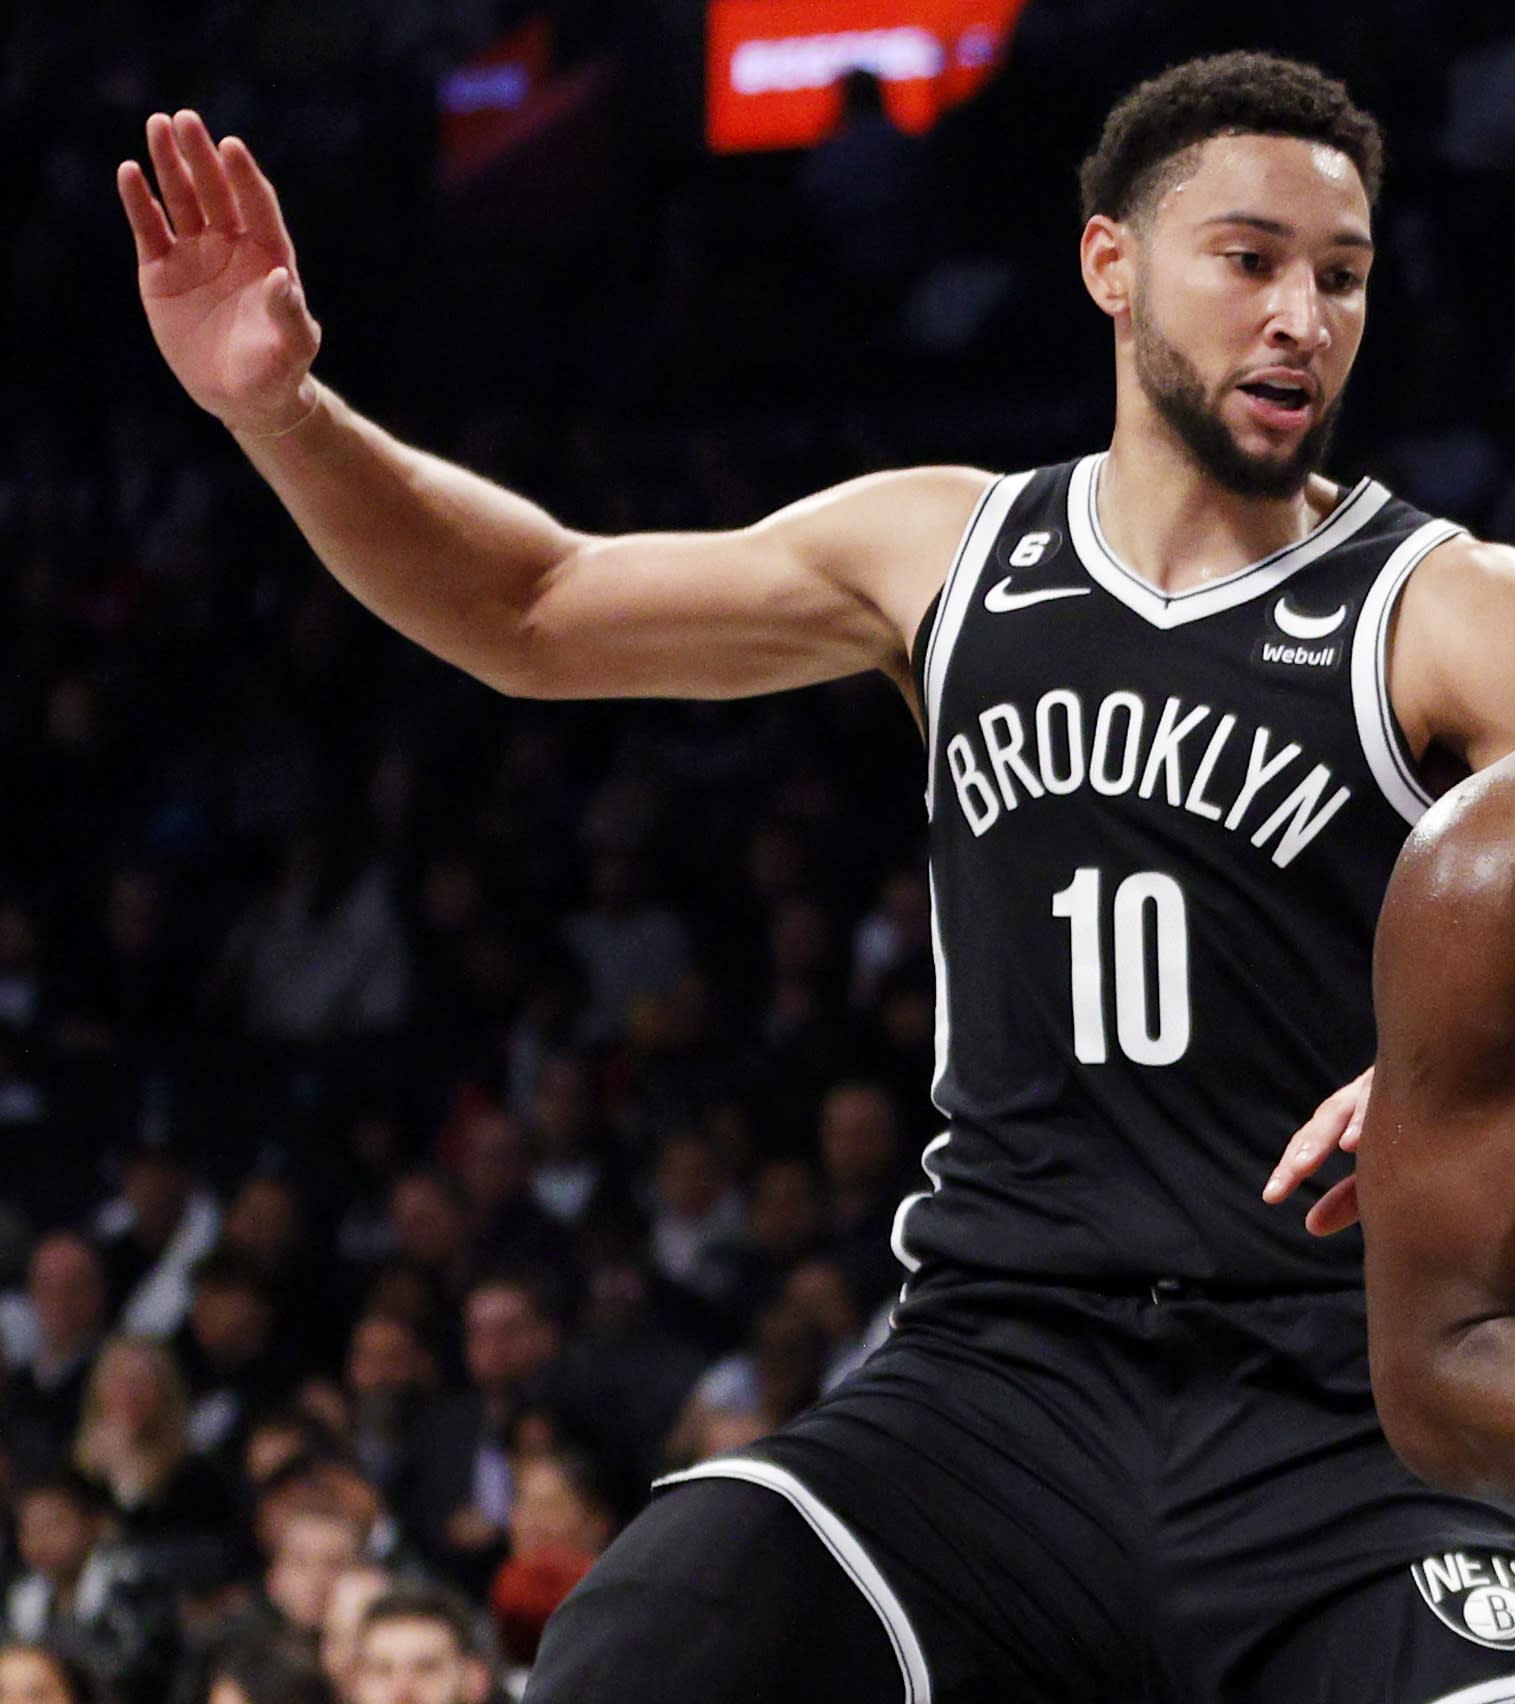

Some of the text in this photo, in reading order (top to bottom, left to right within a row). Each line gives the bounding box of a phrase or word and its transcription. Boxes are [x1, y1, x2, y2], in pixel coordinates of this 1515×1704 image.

[1009, 532, 1050, 567] 6
[1263, 643, 1334, 666] Webull
[946, 689, 1352, 869] BROOKLYN
[1052, 867, 1190, 1066] 10
[1488, 1594, 1515, 1632] B
